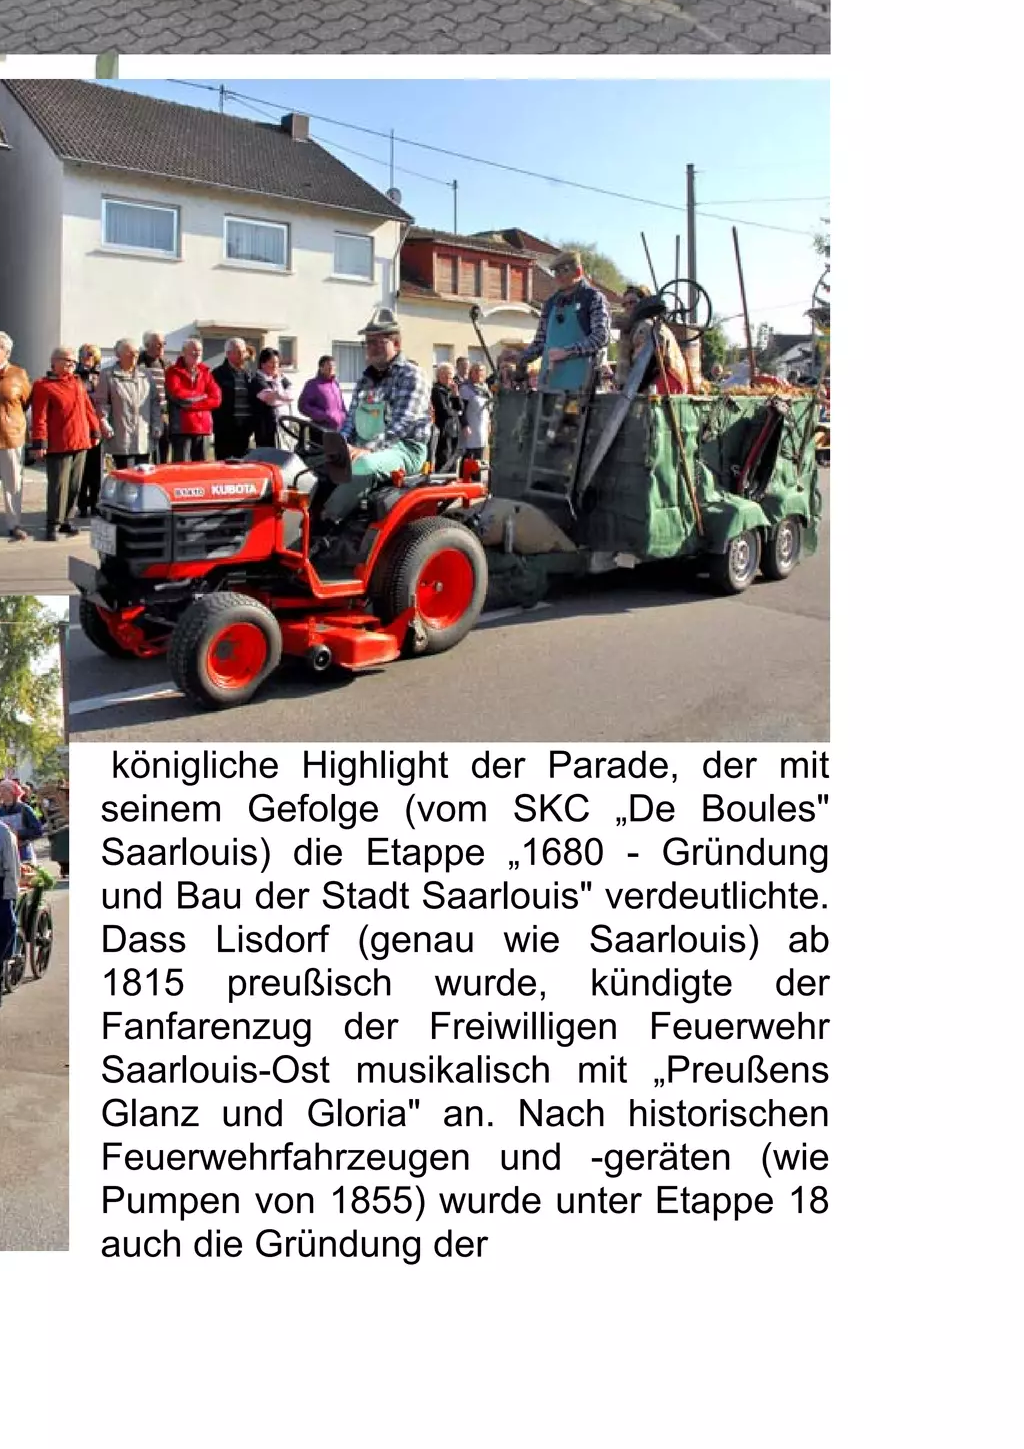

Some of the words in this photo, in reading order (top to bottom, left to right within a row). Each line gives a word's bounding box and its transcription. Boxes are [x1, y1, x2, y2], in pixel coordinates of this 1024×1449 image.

[211, 483, 257, 496] KUBOTA
[112, 749, 279, 787] königliche
[303, 749, 449, 787] Highlight
[471, 750, 527, 779] der
[549, 750, 678, 784] Parade,
[702, 750, 758, 779] der
[780, 750, 830, 779] mit
[101, 793, 221, 823] seinem
[248, 793, 379, 830] Gefolge
[405, 793, 487, 830] (vom
[513, 793, 590, 823] SKC
[616, 793, 676, 827] „De
[702, 793, 829, 823] Boules"
[101, 836, 271, 874] Saarlouis)
[293, 837, 343, 866] die
[367, 837, 485, 874] Etappe
[508, 837, 604, 871] „1680
[662, 836, 828, 874] Gründung
[102, 880, 162, 910] und
[177, 880, 241, 910] Bau
[255, 880, 311, 910] der
[322, 880, 410, 910] Stadt
[422, 880, 592, 910] Saarlouis"
[604, 880, 828, 910] verdeutlichte.
[104, 967, 184, 997] 1815
[228, 967, 391, 1004] preußisch
[434, 967, 546, 1002] wurde,
[591, 967, 733, 1004] kündigte
[775, 967, 831, 997] der
[103, 1010, 312, 1048] Fanfarenzug
[344, 1011, 400, 1040] der
[431, 1011, 617, 1048] Freiwilligen
[651, 1011, 831, 1041] Feuerwehr
[101, 1054, 331, 1084] Saarlouis-Ost
[357, 1054, 550, 1084] musikalisch
[578, 1054, 628, 1084] mit
[654, 1054, 829, 1088] „Preußens
[101, 1098, 200, 1128] Glanz
[223, 1098, 283, 1128] und
[307, 1098, 420, 1128] Gloria"
[443, 1105, 493, 1128] an.
[519, 1098, 604, 1128] Nach
[629, 1098, 828, 1128] historischen
[102, 1185, 240, 1222] Pumpen
[254, 1192, 314, 1215] von
[332, 1184, 426, 1222] 1855)
[438, 1185, 542, 1215] wurde
[557, 1186, 643, 1215] unter
[657, 1185, 774, 1222] Etappe
[791, 1185, 829, 1215] 18
